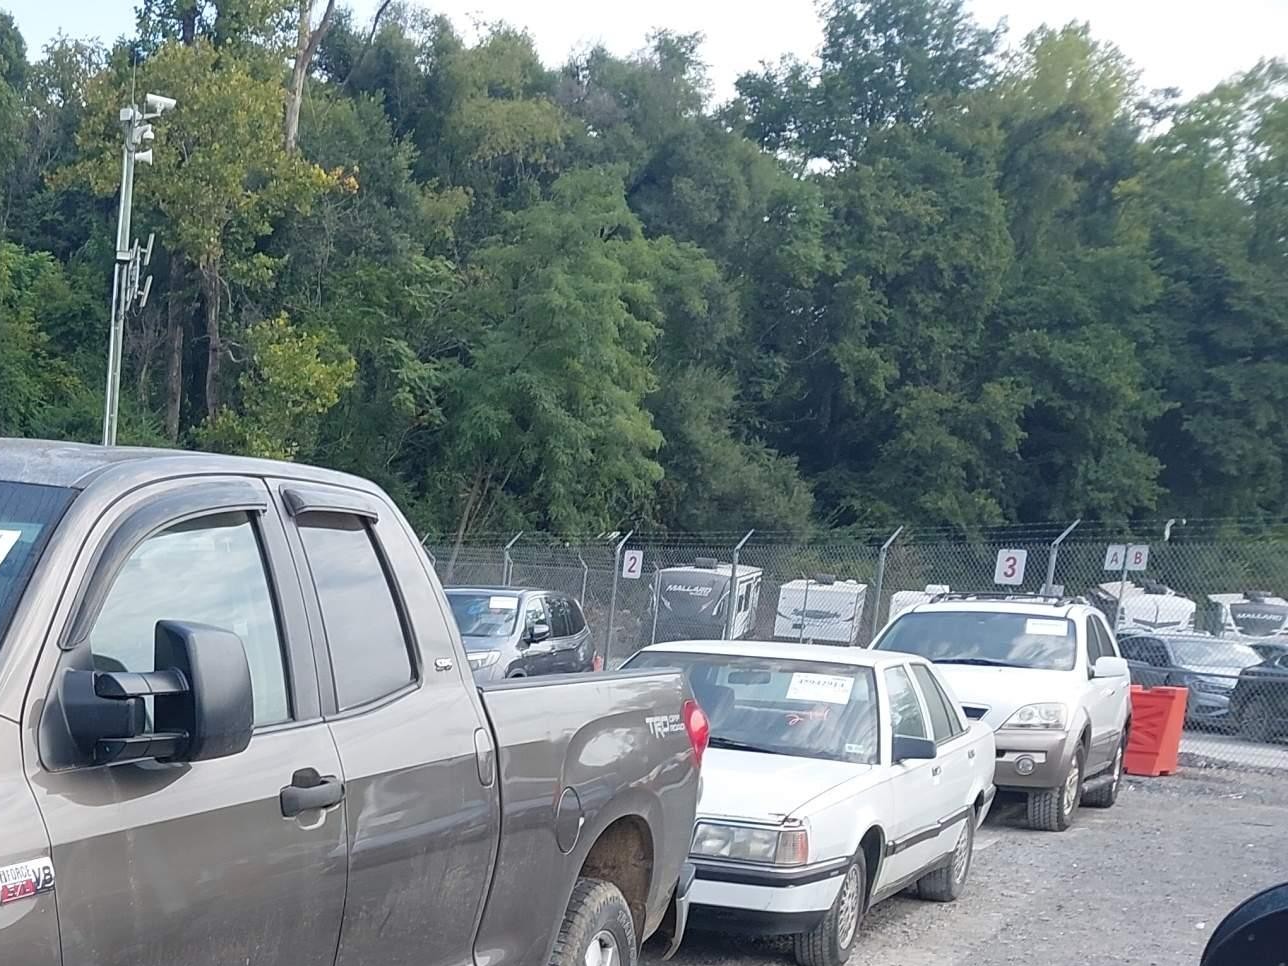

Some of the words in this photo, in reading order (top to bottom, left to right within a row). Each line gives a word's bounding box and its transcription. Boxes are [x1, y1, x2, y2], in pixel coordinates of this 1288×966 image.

[627, 555, 637, 573] 2
[1003, 556, 1017, 578] 3
[1110, 552, 1119, 564] A
[1133, 551, 1143, 565] B
[666, 584, 712, 594] MALLARD
[645, 715, 669, 739] TRD
[32, 865, 53, 889] V8
